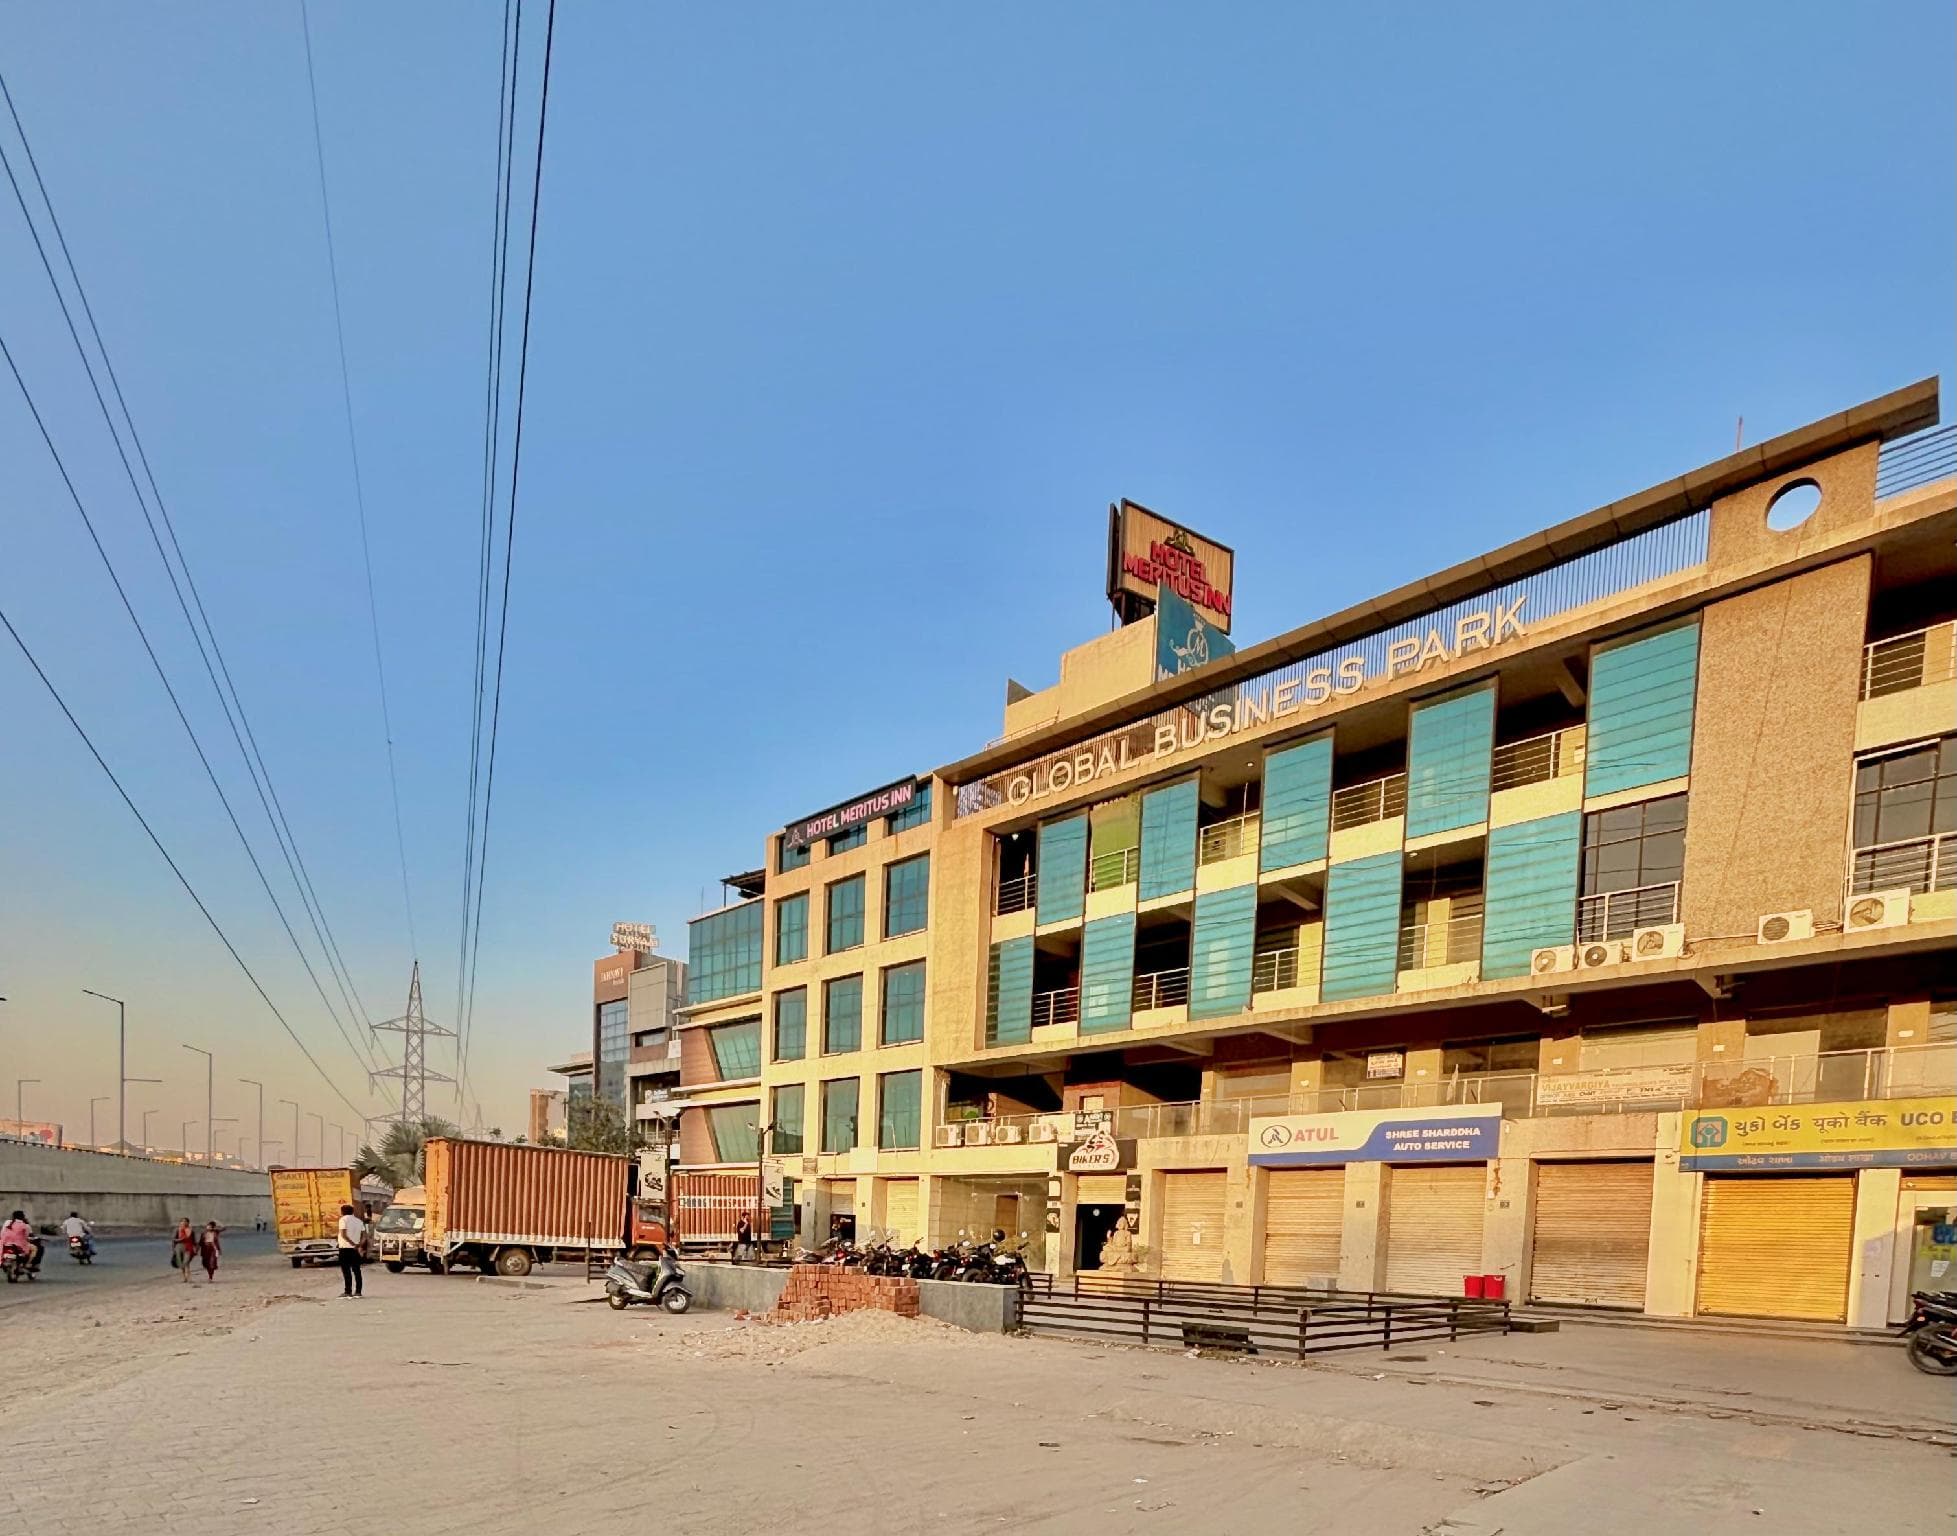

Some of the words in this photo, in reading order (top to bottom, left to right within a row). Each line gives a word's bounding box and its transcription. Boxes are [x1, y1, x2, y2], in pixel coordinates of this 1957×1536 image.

[1151, 540, 1208, 585] HOTEL
[1123, 552, 1202, 605] MERITUS
[1202, 584, 1231, 616] INN
[1007, 737, 1143, 806] GLOBAL
[1154, 656, 1367, 759] BUSINESS
[1386, 596, 1529, 681] PARK
[806, 814, 840, 838] HOTEL
[840, 793, 889, 825] MERITUS
[890, 784, 912, 807] INN
[615, 922, 651, 934] HOTEL
[1900, 1112, 1944, 1126] UCO
[1294, 1128, 1339, 1142] ATUL
[1385, 1130, 1420, 1139] SHREE
[1422, 1127, 1481, 1138] SHARDDHA
[1393, 1142, 1422, 1151] AUTO
[1424, 1140, 1471, 1151] SERVICE
